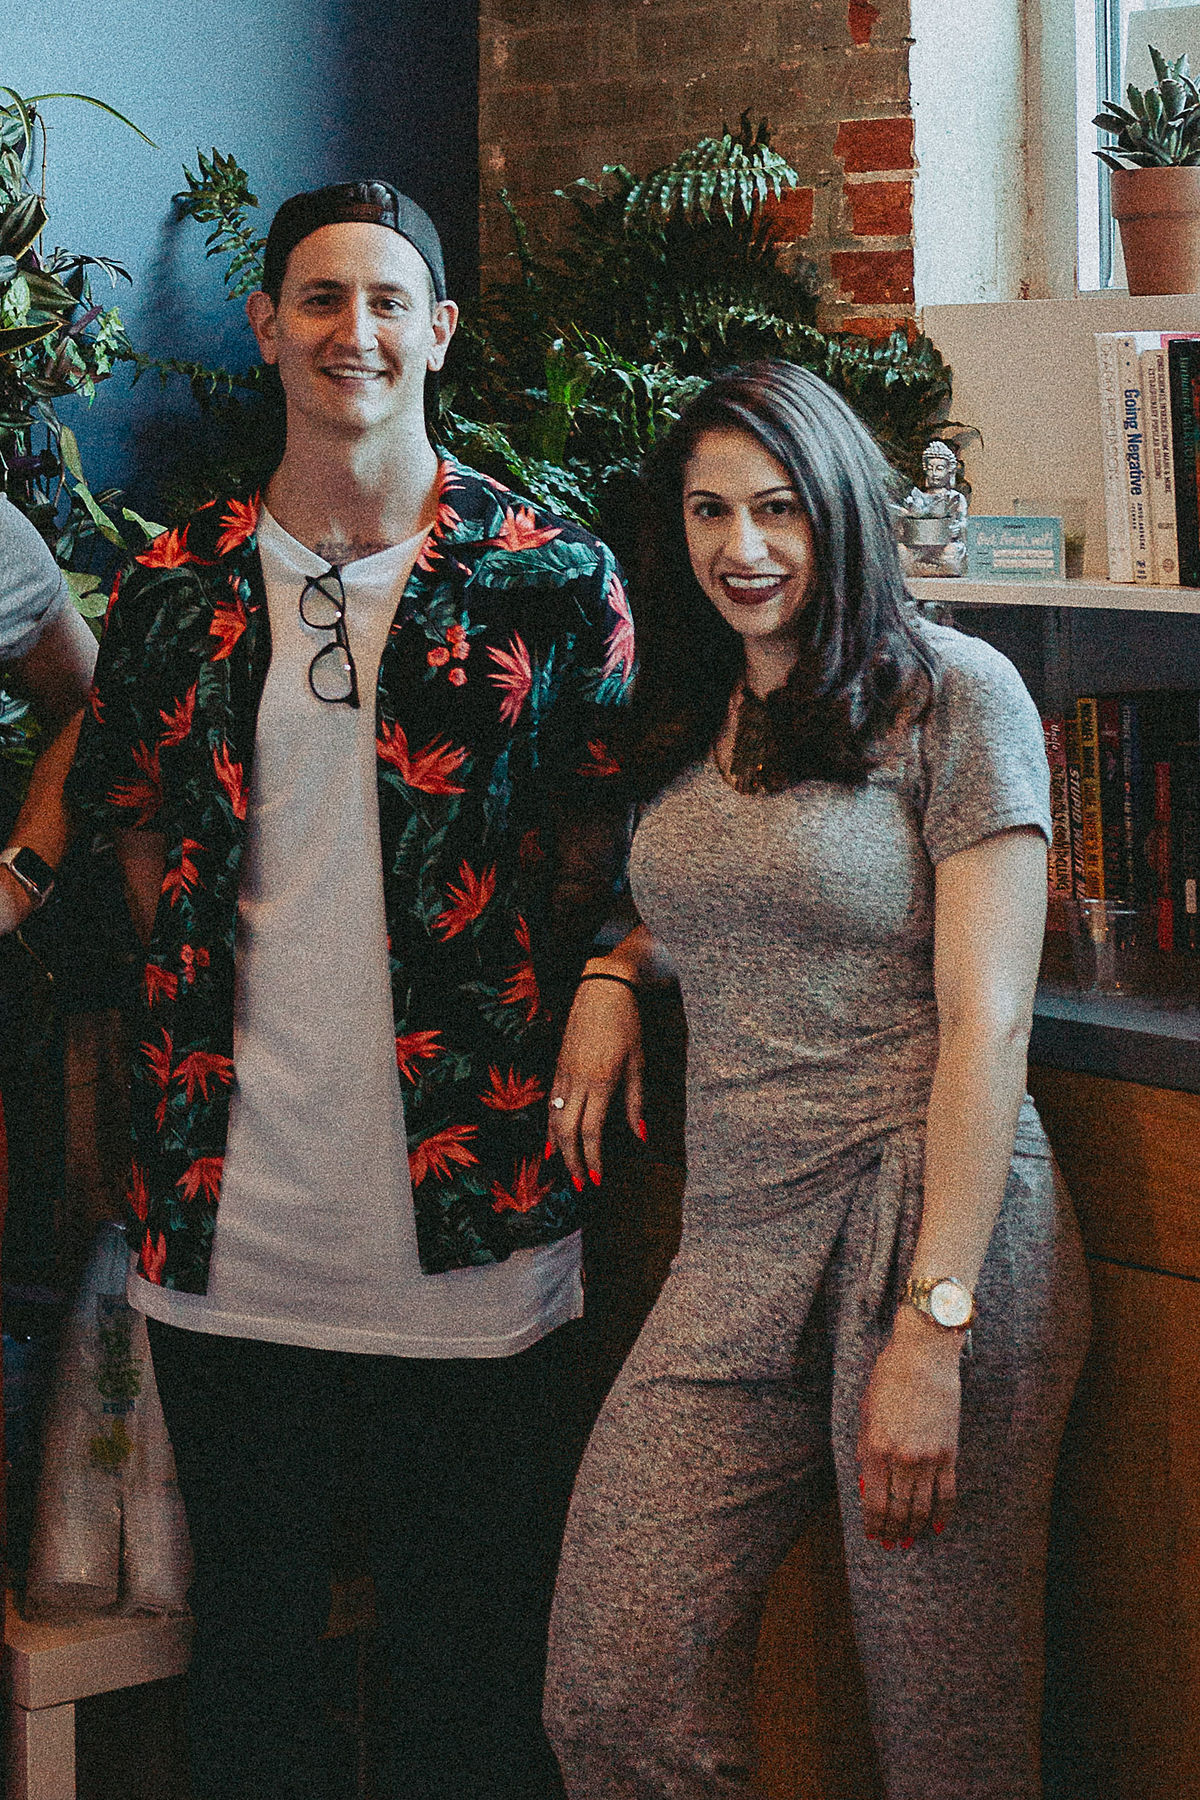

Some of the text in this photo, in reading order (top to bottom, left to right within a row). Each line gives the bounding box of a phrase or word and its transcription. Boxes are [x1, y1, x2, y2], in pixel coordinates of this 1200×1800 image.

[1123, 389, 1145, 496] Going Negative
[1069, 766, 1083, 825] STUPID
[1072, 826, 1086, 876] WHITE
[1075, 876, 1088, 900] ME
